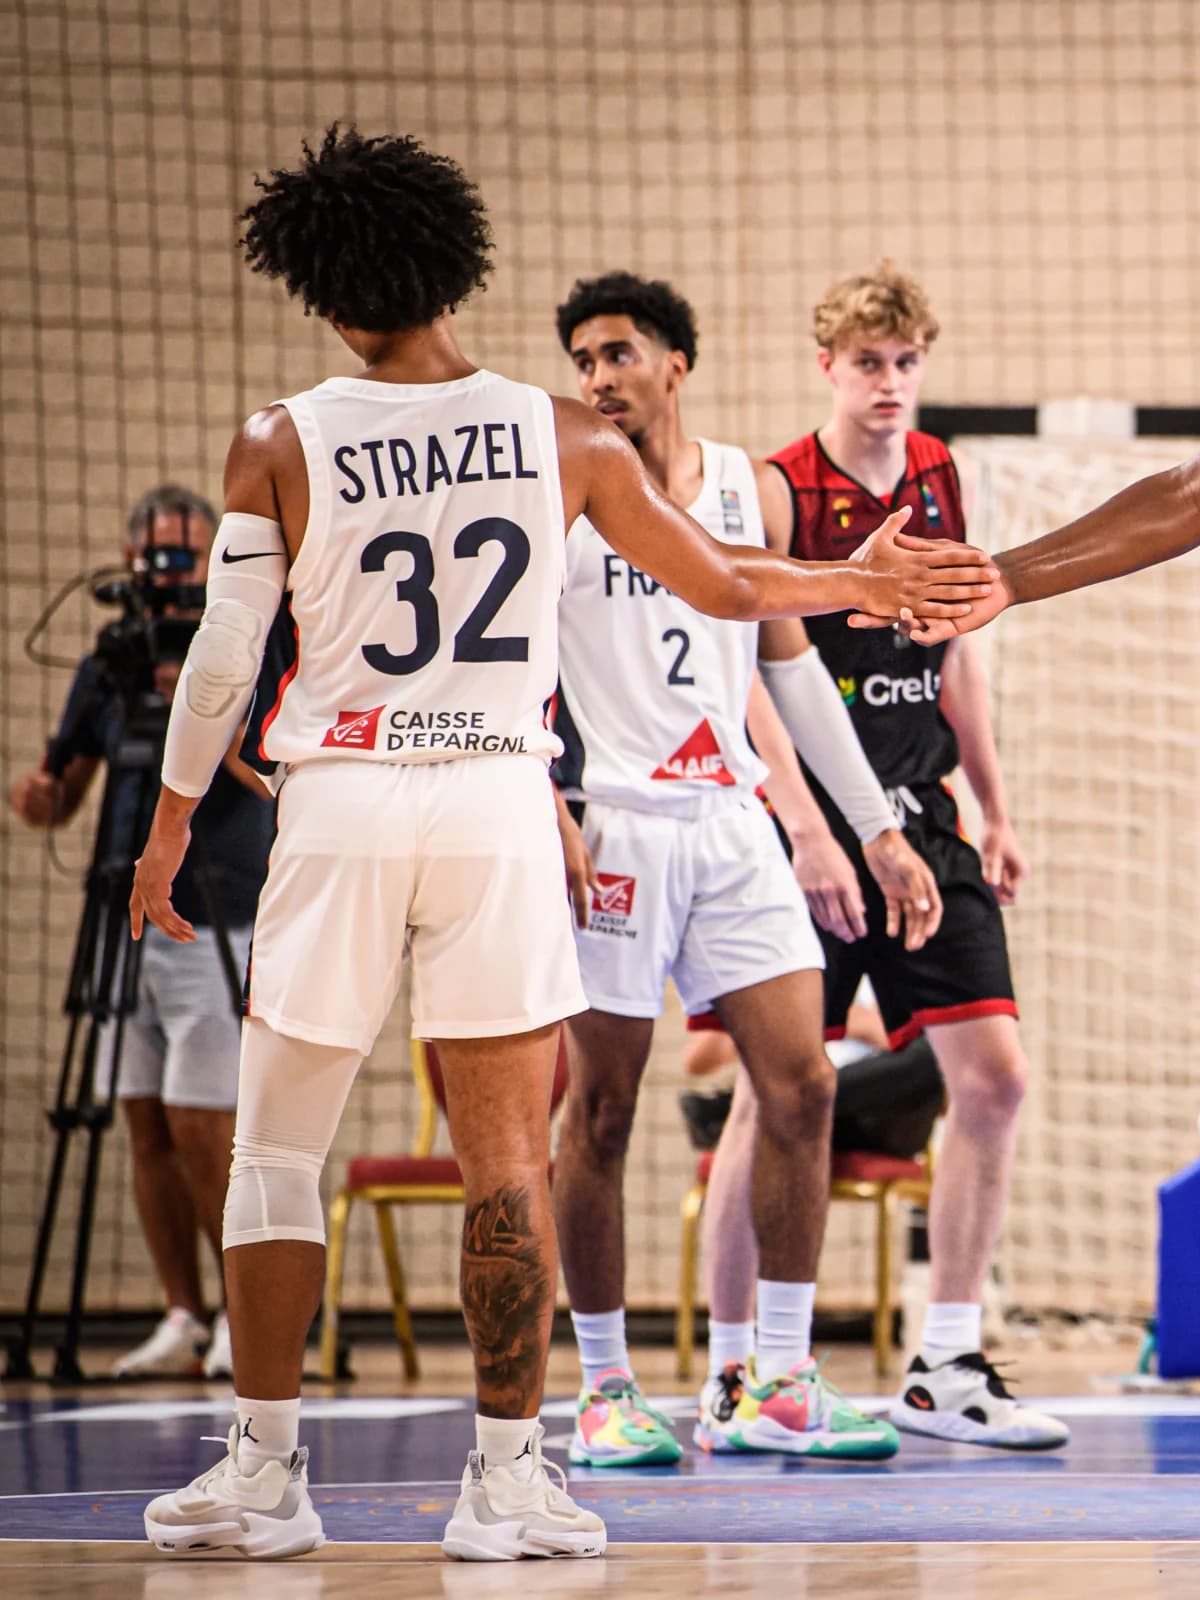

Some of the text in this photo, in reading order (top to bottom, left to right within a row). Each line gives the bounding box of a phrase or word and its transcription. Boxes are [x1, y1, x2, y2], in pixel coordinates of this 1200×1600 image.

[334, 423, 538, 504] STRAZEL
[360, 517, 531, 676] 32
[662, 628, 695, 686] 2
[390, 710, 485, 729] CAISSE
